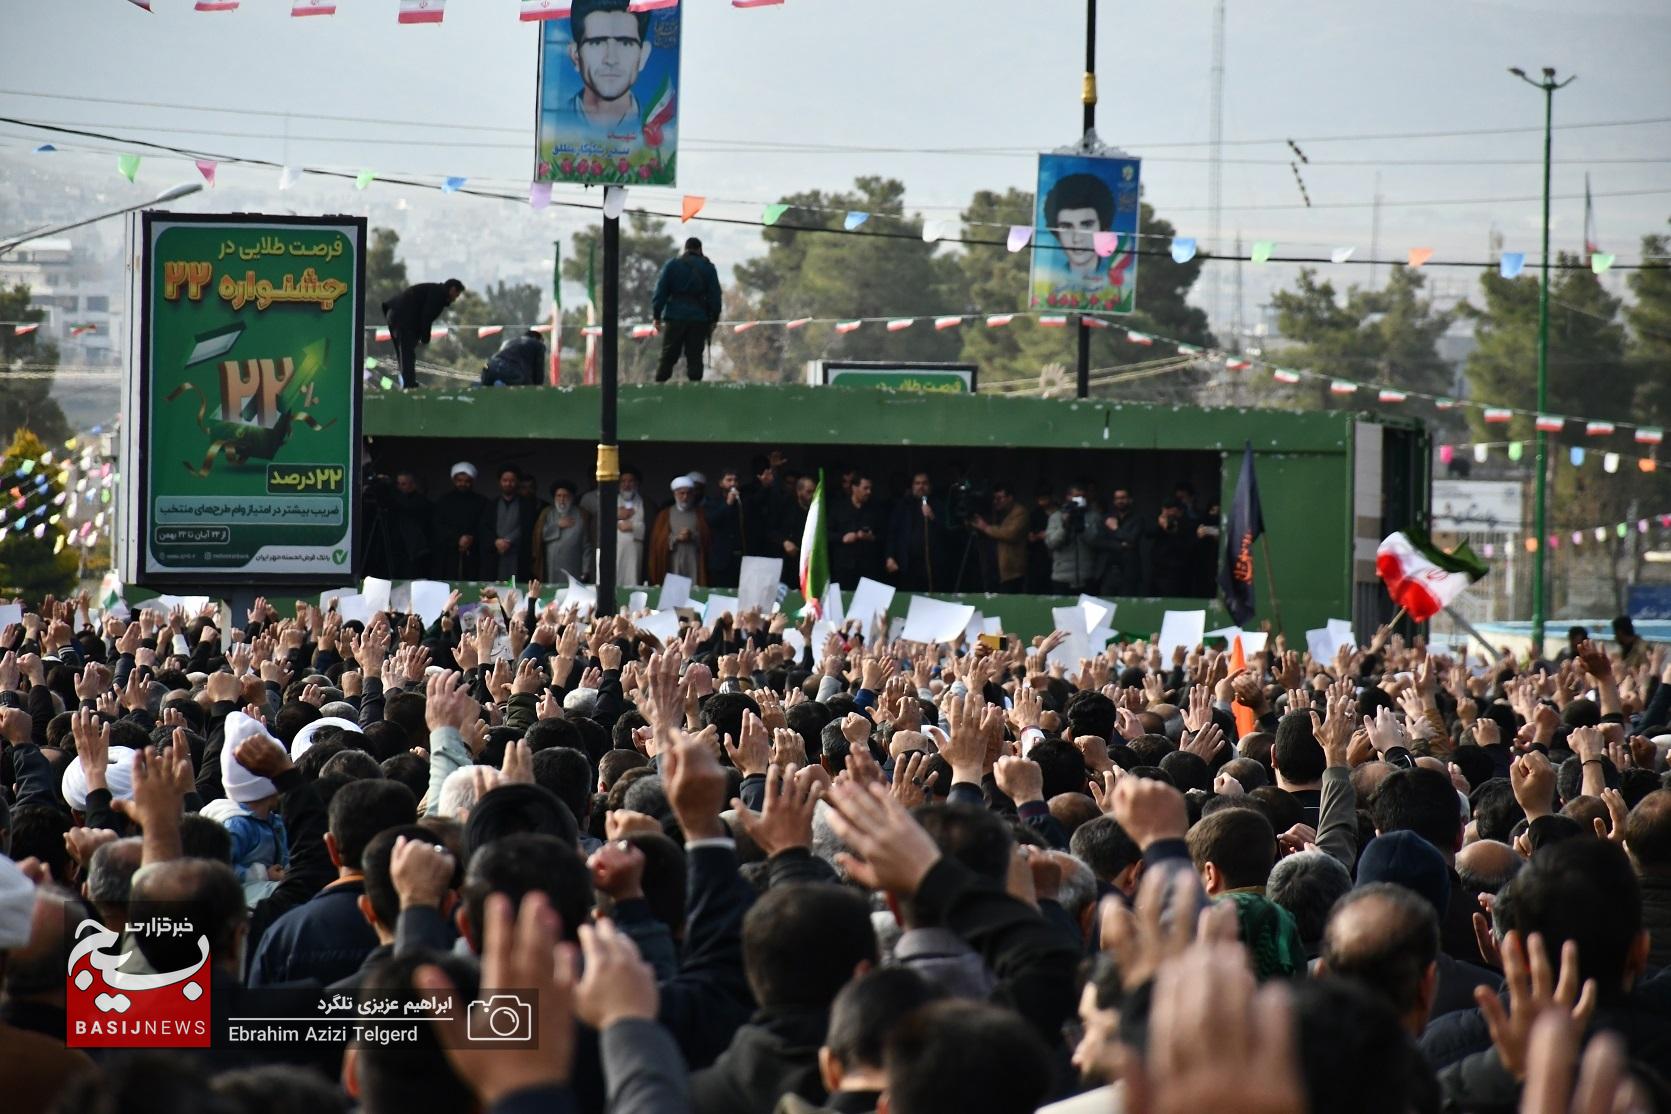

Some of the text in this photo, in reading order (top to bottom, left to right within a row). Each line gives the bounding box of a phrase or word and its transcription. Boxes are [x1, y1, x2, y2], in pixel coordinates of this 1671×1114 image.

[218, 234, 343, 262] فرصت طلایی در
[164, 261, 348, 311] جشنواره ۲۲
[160, 504, 193, 516] منتخب
[231, 504, 246, 517] وام
[246, 503, 272, 517] امتیاز
[271, 507, 281, 516] در
[281, 504, 310, 517] بیشتر
[311, 505, 340, 517] ضریب
[159, 532, 177, 541] بهمن
[187, 530, 194, 538] تا
[195, 529, 210, 541] آبان
